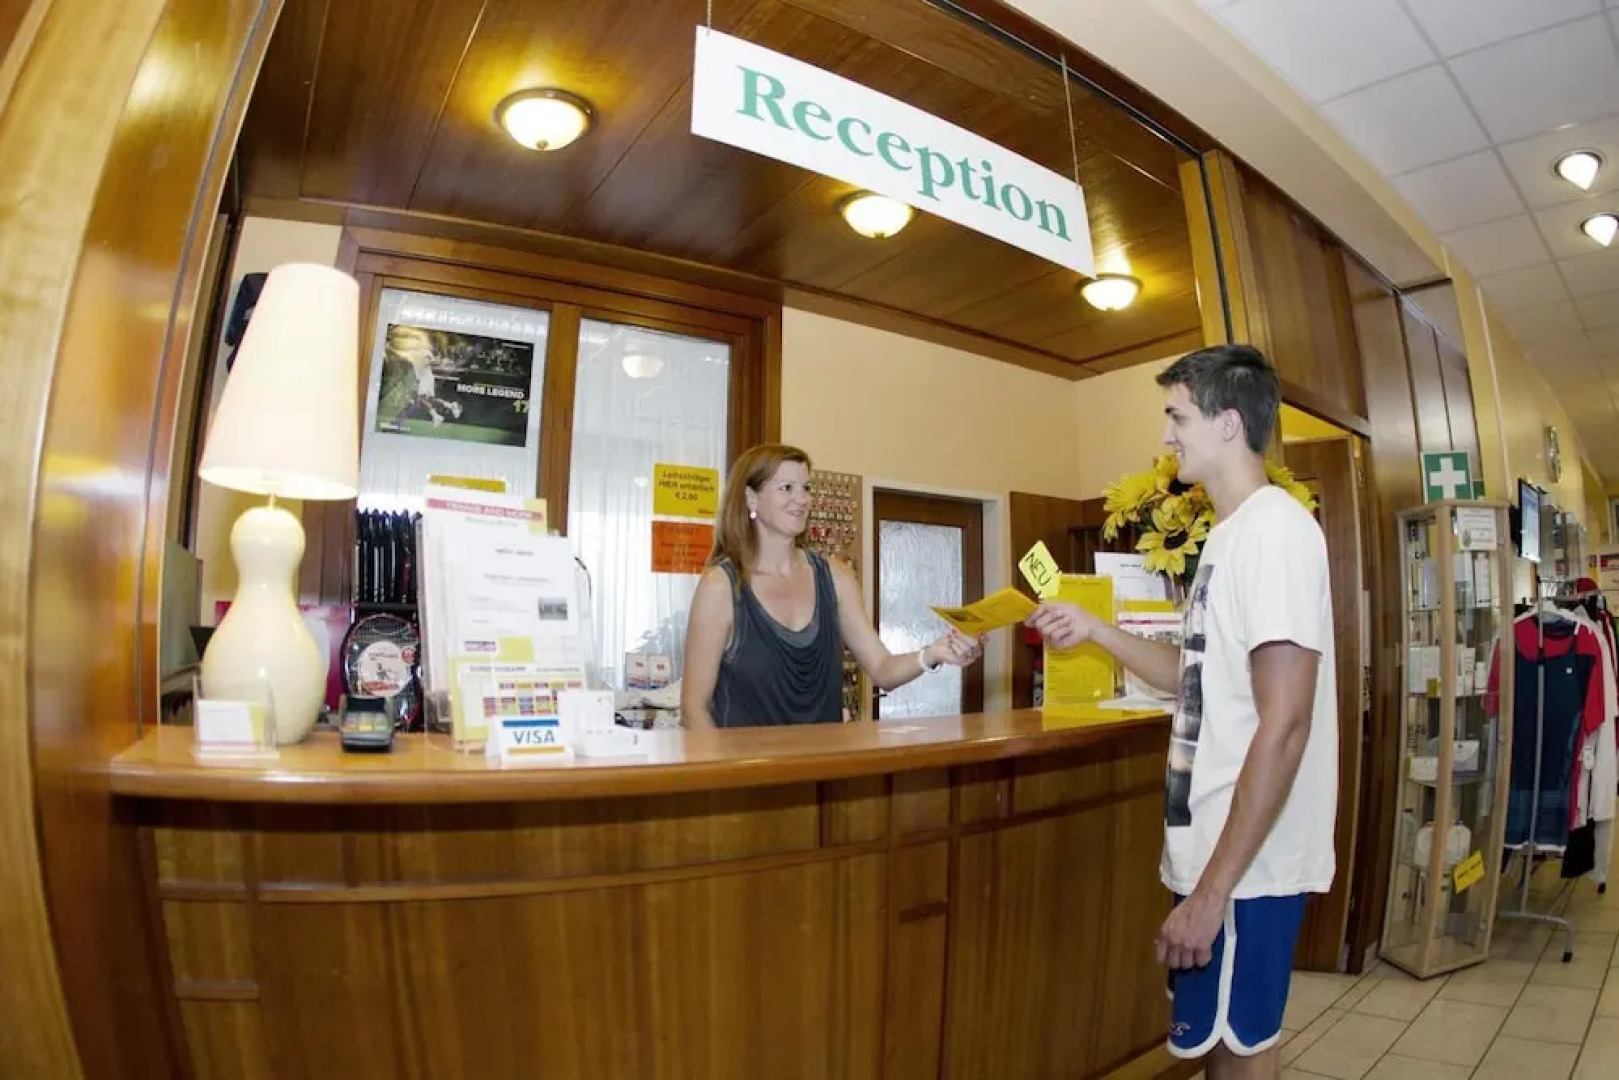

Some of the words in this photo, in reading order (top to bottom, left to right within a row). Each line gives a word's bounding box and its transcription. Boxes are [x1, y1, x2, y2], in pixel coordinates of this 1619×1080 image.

[735, 65, 1072, 243] Reception
[486, 388, 524, 399] LEGEND
[1026, 553, 1051, 587] NEU
[513, 729, 555, 744] VISA
